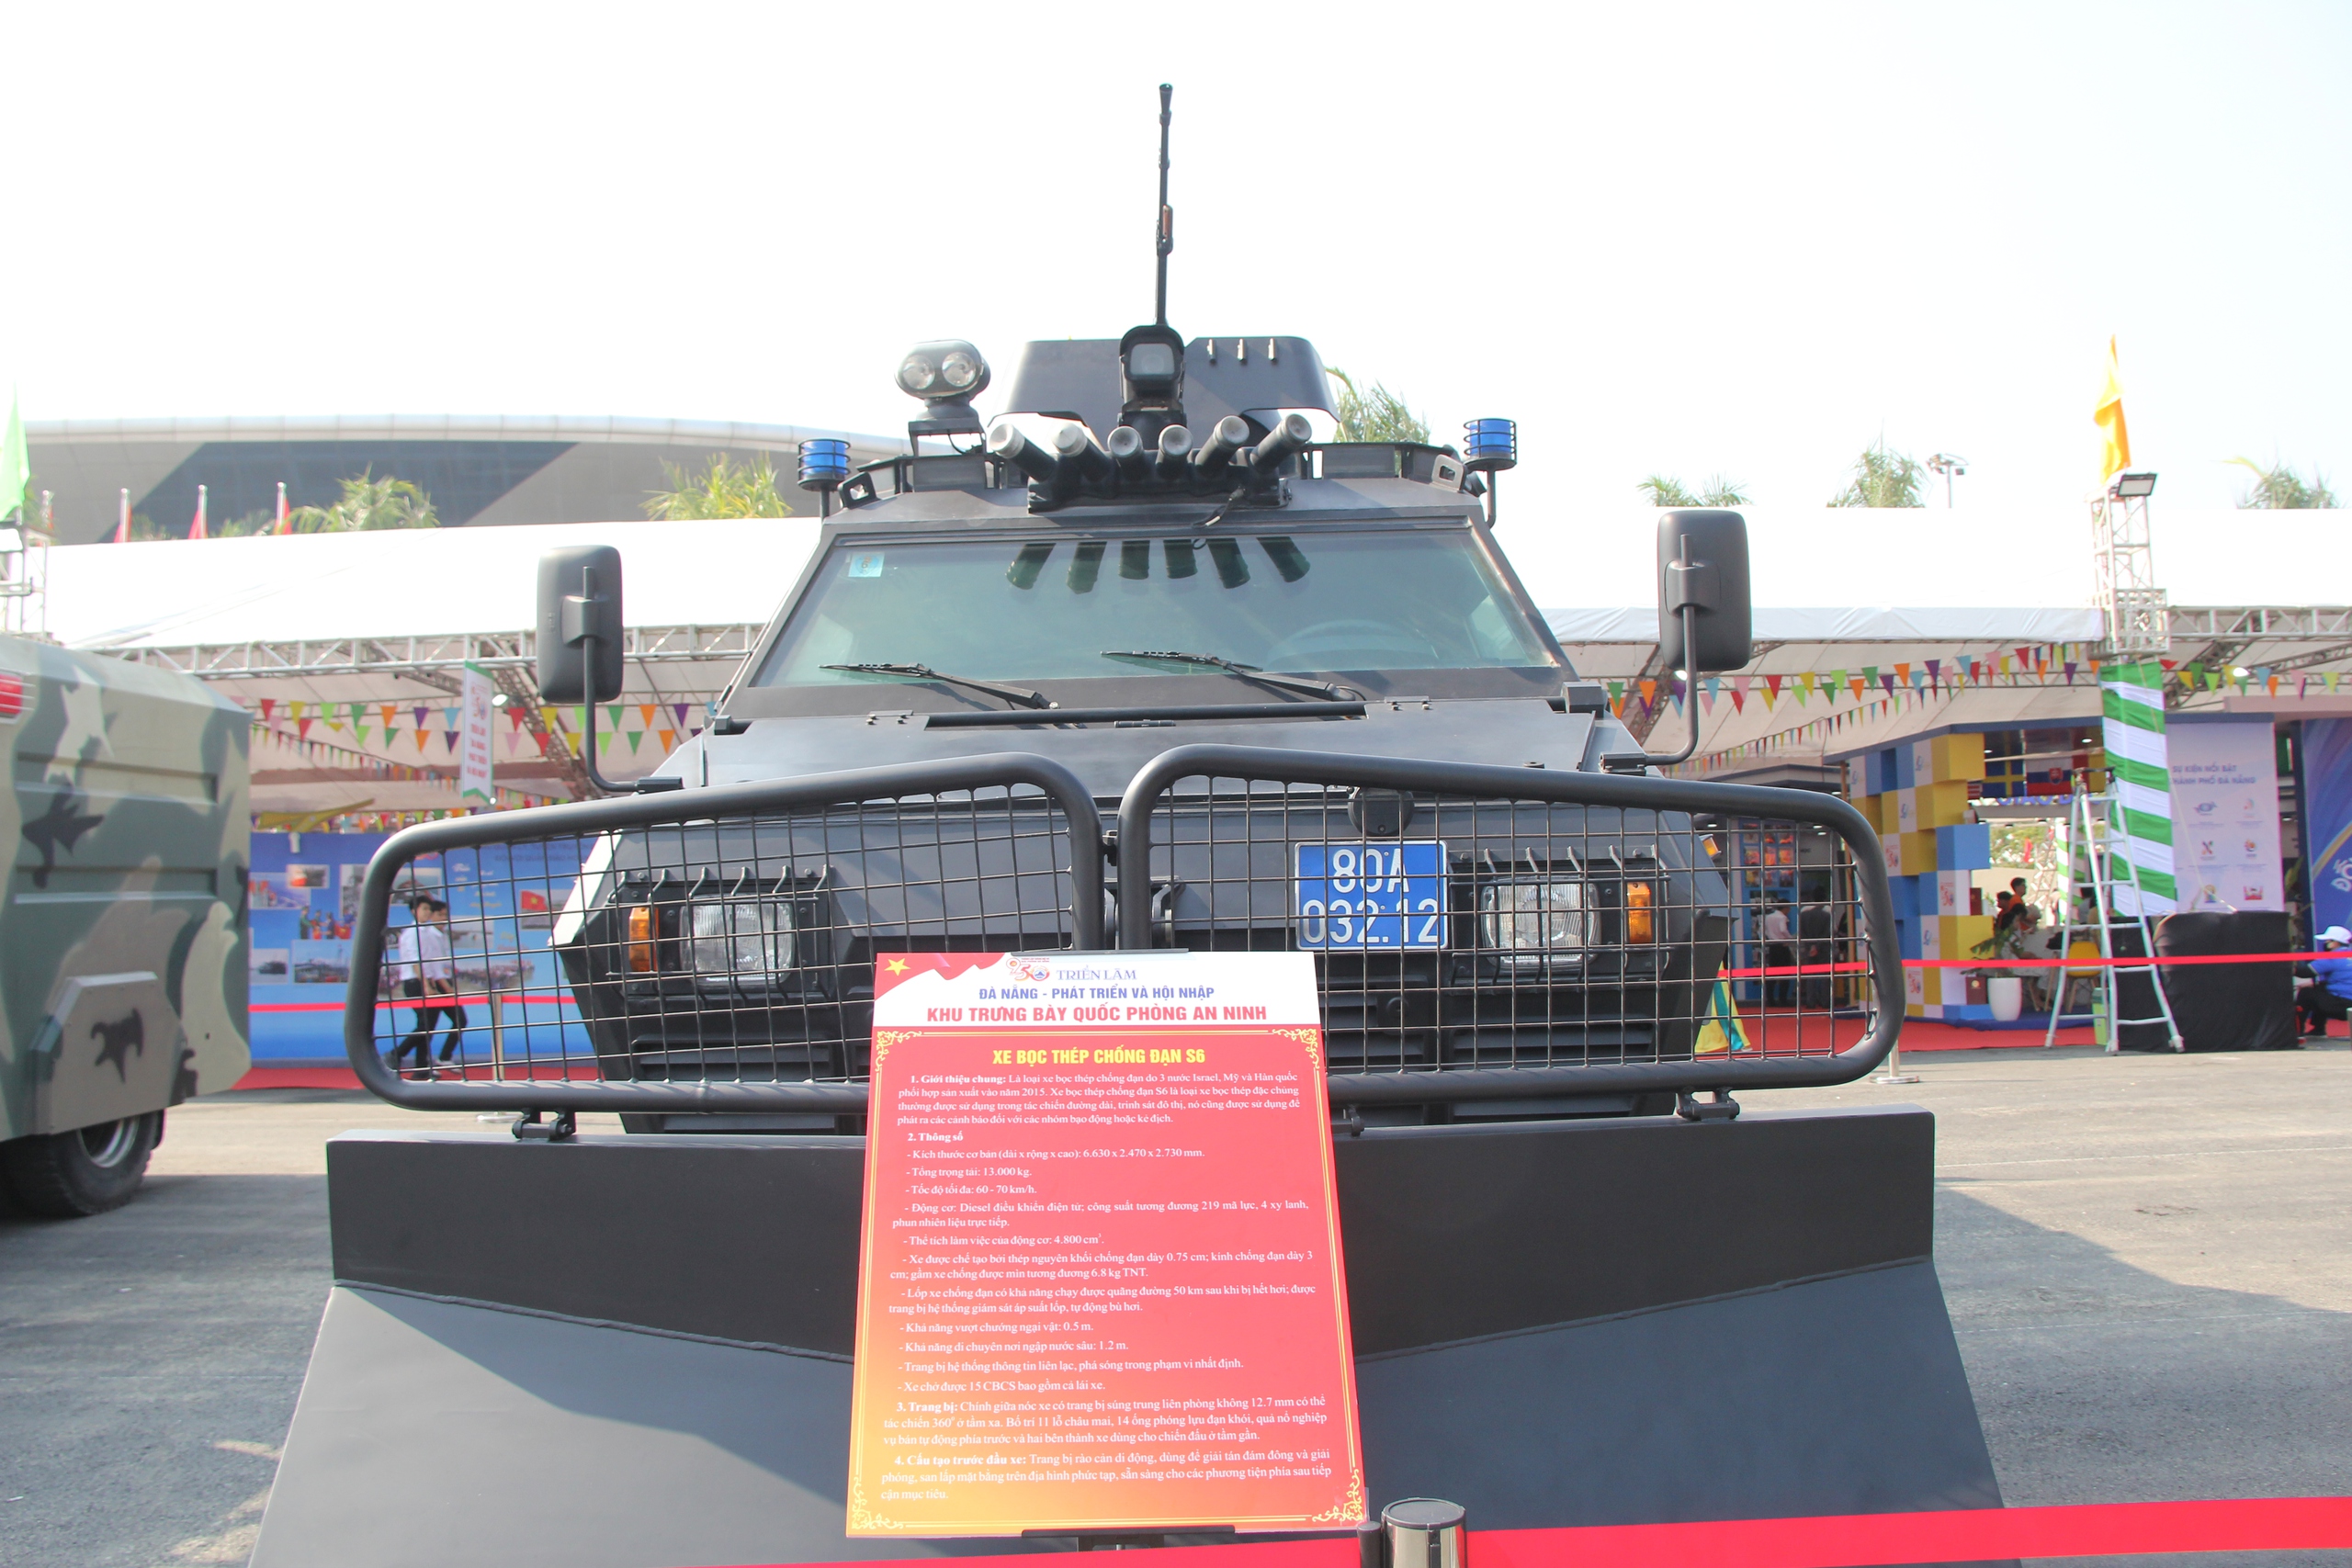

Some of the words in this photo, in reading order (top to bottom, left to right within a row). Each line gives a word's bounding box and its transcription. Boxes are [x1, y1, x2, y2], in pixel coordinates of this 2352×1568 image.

[1332, 848, 1410, 894] 80A
[1303, 898, 1441, 944] 032.12
[1056, 965, 1102, 981] TRIỂN
[978, 987, 997, 999] ĐÀ
[1001, 984, 1038, 999] NẴNG
[1052, 986, 1086, 999] PHÁT
[1091, 984, 1127, 999] TRIỂN
[1132, 985, 1148, 999] VÀ
[1152, 986, 1174, 1000] HỘI
[1179, 985, 1215, 1001] NHẬP
[927, 1008, 963, 1021] KHU
[968, 1006, 1027, 1021] TRƯNG
[1033, 1004, 1067, 1021] BÀY
[1073, 1001, 1120, 1022] QUỐC
[1126, 1003, 1187, 1021] PHÒNG
[1193, 1006, 1217, 1021] AN
[1223, 1006, 1267, 1021] NINH
[992, 1049, 1012, 1065] XE
[1016, 1049, 1047, 1067] BỌC
[1051, 1046, 1090, 1064] THÉP
[1093, 1044, 1146, 1064] CHỐNG
[1149, 1048, 1182, 1066] ĐẠN
[1186, 1049, 1205, 1064] S6
[910, 1075, 919, 1083] 1.
[921, 1075, 943, 1083] Giới
[944, 1075, 970, 1085] thiệu
[971, 1075, 1005, 1085] chung:
[1009, 1074, 1021, 1082] Là
[1023, 1074, 1040, 1084] loại
[1055, 1074, 1072, 1084] bọc
[1074, 1074, 1094, 1084] thép
[1095, 1071, 1125, 1084] chống
[1126, 1073, 1143, 1083] đạn
[1145, 1073, 1158, 1082] do
[1159, 1073, 1165, 1082] 3
[1167, 1073, 1191, 1082] nước
[1193, 1073, 1221, 1082] Israel,
[1223, 1073, 1238, 1083] Mỹ
[1240, 1073, 1252, 1081] và
[1254, 1072, 1273, 1081] Hàn
[1274, 1070, 1297, 1082] quốc
[897, 1115, 917, 1126] phát
[930, 1115, 945, 1123] các
[971, 1115, 989, 1123] báo
[989, 1112, 1005, 1123] đối
[1007, 1114, 1022, 1123] với
[1023, 1114, 1039, 1123] các
[1041, 1114, 1068, 1122] nhóm
[1069, 1114, 1087, 1124] bạo
[1088, 1114, 1112, 1125] động
[1114, 1113, 1136, 1124] hoặc
[1149, 1113, 1173, 1123] địch.
[907, 1132, 916, 1141] 2.
[917, 1132, 951, 1143] Thông
[952, 1130, 963, 1141] số
[912, 1149, 935, 1158] Kích
[937, 1149, 965, 1158] thước
[998, 1149, 1016, 1159] (dài
[1026, 1149, 1048, 1160] rộng
[1057, 1149, 1080, 1158] cao):
[1082, 1148, 1110, 1157] 6.630
[1119, 1148, 1147, 1157] 2.470
[1155, 1148, 1182, 1157] 2.730
[912, 1166, 937, 1179] Tổng
[938, 1168, 964, 1179] trọng
[984, 1167, 1015, 1176] 13.000
[1017, 1167, 1032, 1178] kg.
[910, 1182, 930, 1194] Tốc
[931, 1185, 944, 1195] độ
[944, 1182, 957, 1193] tối
[958, 1185, 974, 1193] đa:
[975, 1185, 989, 1193] 60
[996, 1185, 1008, 1193] 70
[1009, 1184, 1036, 1193] km/h.
[889, 1271, 909, 1280] cm;
[946, 1267, 978, 1280] chống
[978, 1269, 1003, 1280] được
[1026, 1269, 1056, 1280] tương
[1057, 1268, 1090, 1280] đương
[1091, 1268, 1106, 1277] 6.8
[1108, 1268, 1121, 1279] kg
[1122, 1267, 1148, 1277] TNT.
[928, 1323, 953, 1335] năng
[955, 1324, 978, 1333] vượt
[978, 1322, 1018, 1334] chướng
[1019, 1321, 1040, 1334] ngại
[1043, 1321, 1060, 1333] vật:
[1063, 1321, 1079, 1331] 0.5
[903, 1382, 919, 1392] Xe
[941, 1381, 967, 1393] được
[970, 1381, 981, 1391] 15
[982, 1381, 1016, 1391] CBCS
[1017, 1381, 1036, 1391] bao
[1037, 1378, 1060, 1393] gồm
[1076, 1380, 1088, 1390] lái
[1090, 1382, 1105, 1390] xe.
[894, 1455, 904, 1465] 4.
[906, 1452, 930, 1465] Cấu
[933, 1456, 950, 1468] tạo
[953, 1454, 983, 1465] trước
[986, 1451, 1007, 1464] đầu
[1010, 1456, 1025, 1464] xe:
[1029, 1453, 1059, 1466] Trang
[1062, 1453, 1072, 1465] bị
[1114, 1452, 1125, 1462] di
[1126, 1452, 1157, 1465] động,
[1159, 1451, 1185, 1464] dùng
[1224, 1450, 1240, 1461] tán
[1242, 1450, 1265, 1461] đám
[1267, 1450, 1294, 1462] đông
[1295, 1449, 1308, 1459] và
[880, 1488, 899, 1501] cận
[900, 1491, 923, 1501] mục
[925, 1488, 948, 1499] tiêu.
